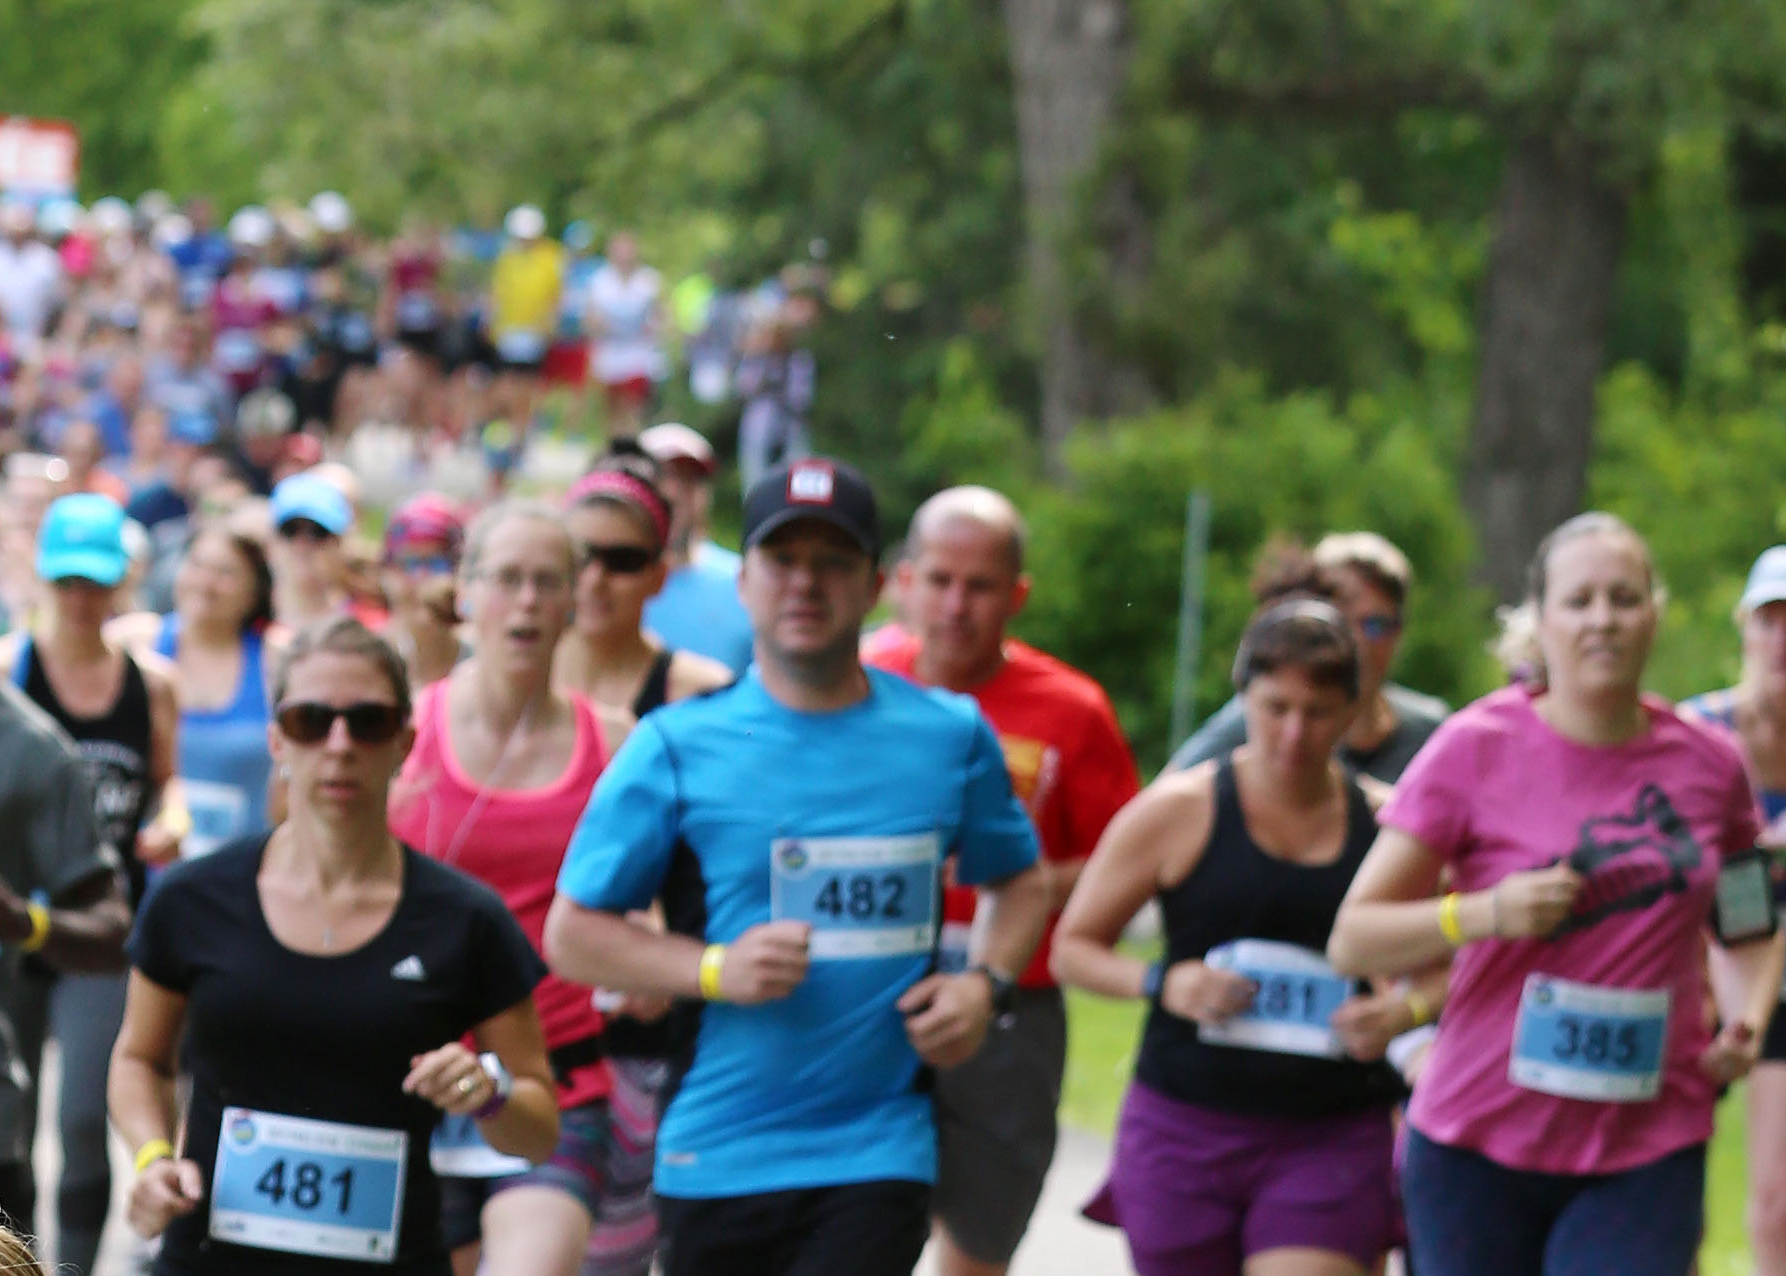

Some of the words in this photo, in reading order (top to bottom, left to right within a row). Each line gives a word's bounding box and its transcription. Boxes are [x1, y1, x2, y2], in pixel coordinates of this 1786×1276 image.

[814, 875, 907, 921] 482
[1553, 1014, 1639, 1068] 385
[255, 1158, 355, 1215] 481
